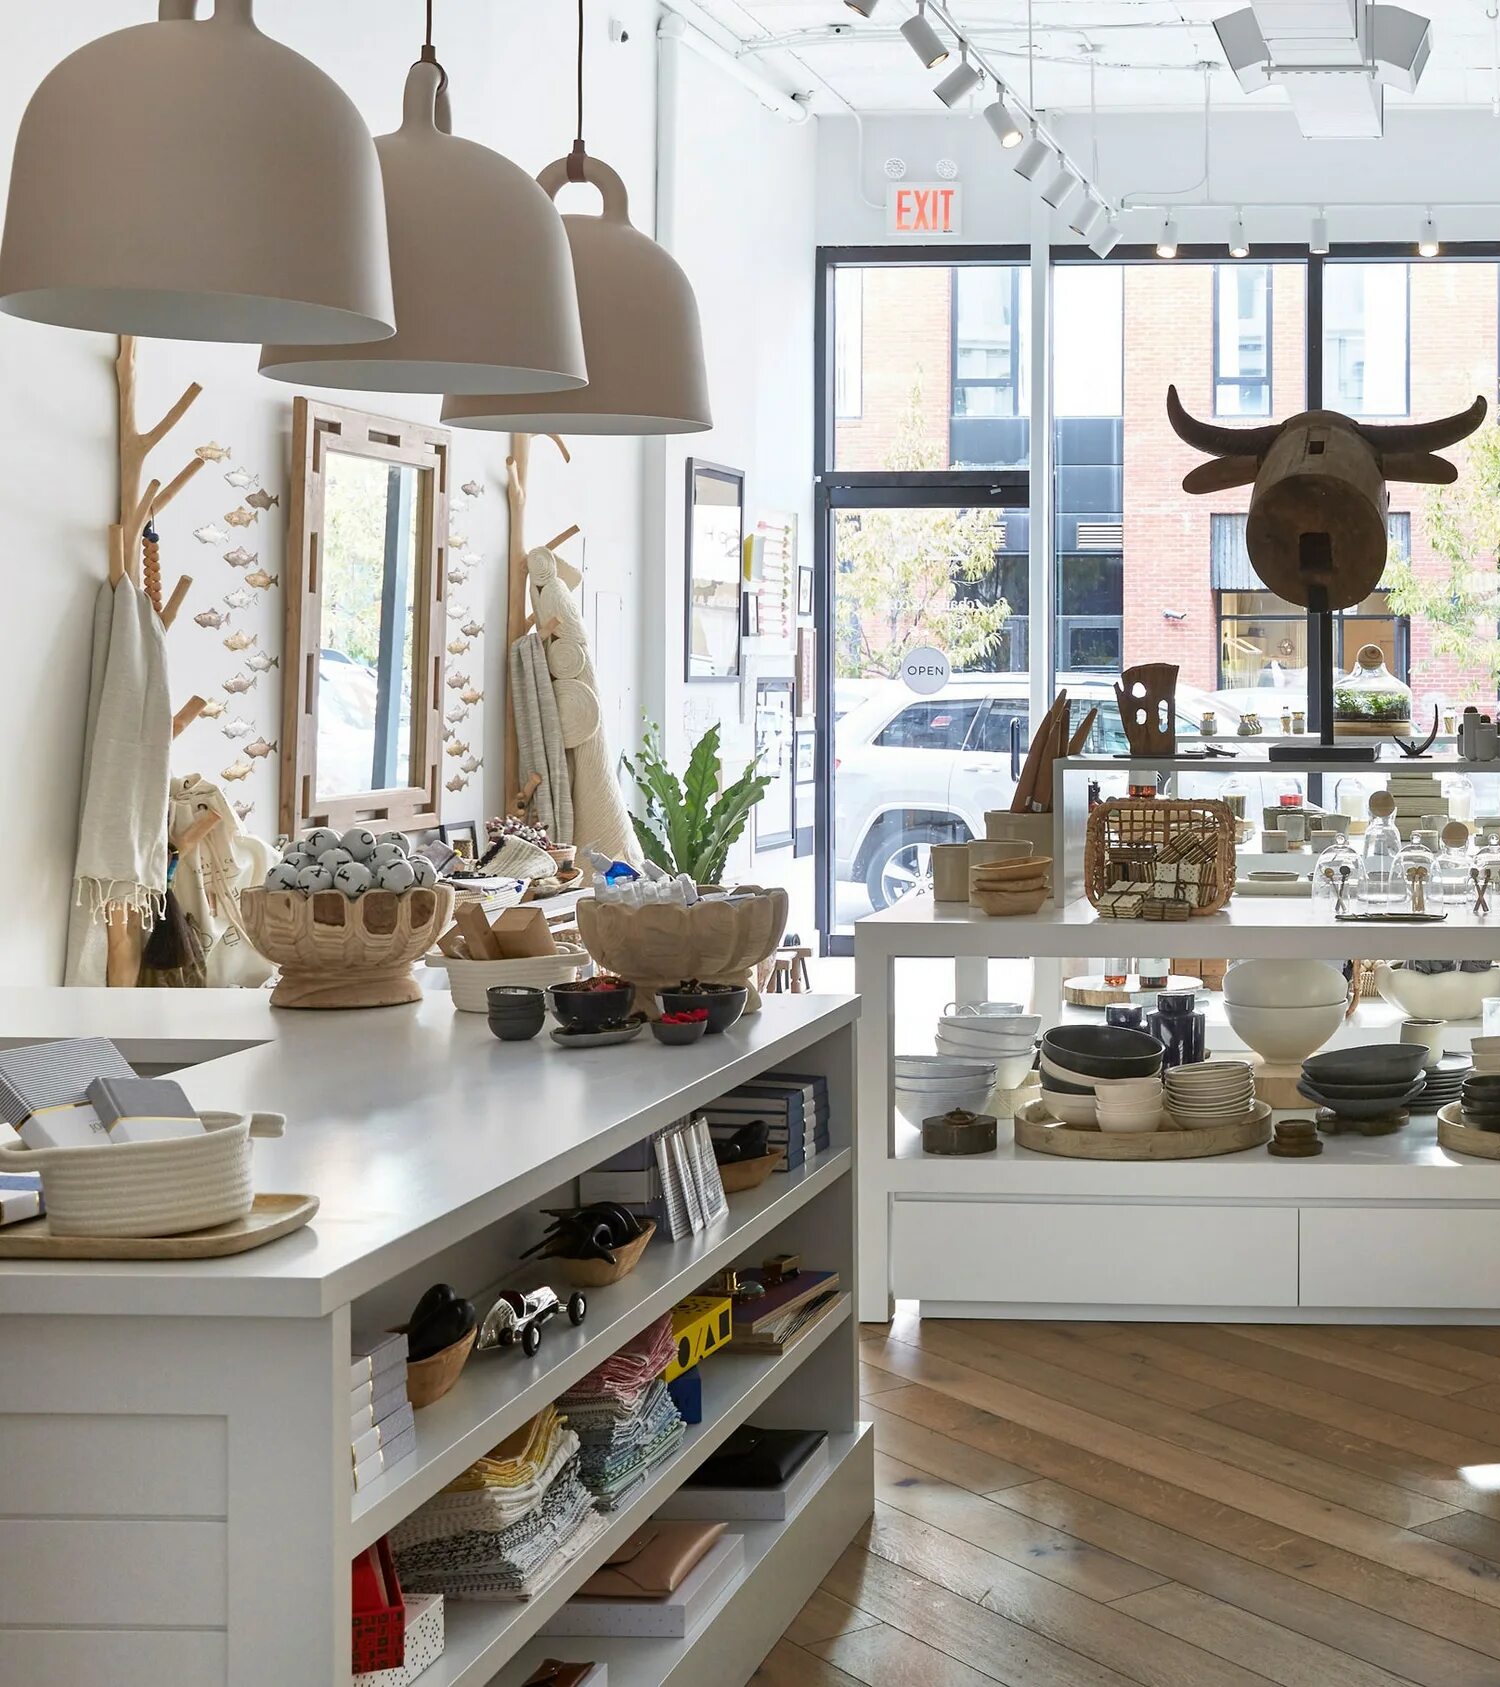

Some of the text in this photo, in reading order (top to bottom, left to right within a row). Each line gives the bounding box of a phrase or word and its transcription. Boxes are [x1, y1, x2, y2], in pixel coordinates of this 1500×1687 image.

[896, 190, 955, 230] EXIT
[907, 665, 944, 676] OPEN
[308, 832, 325, 846] K
